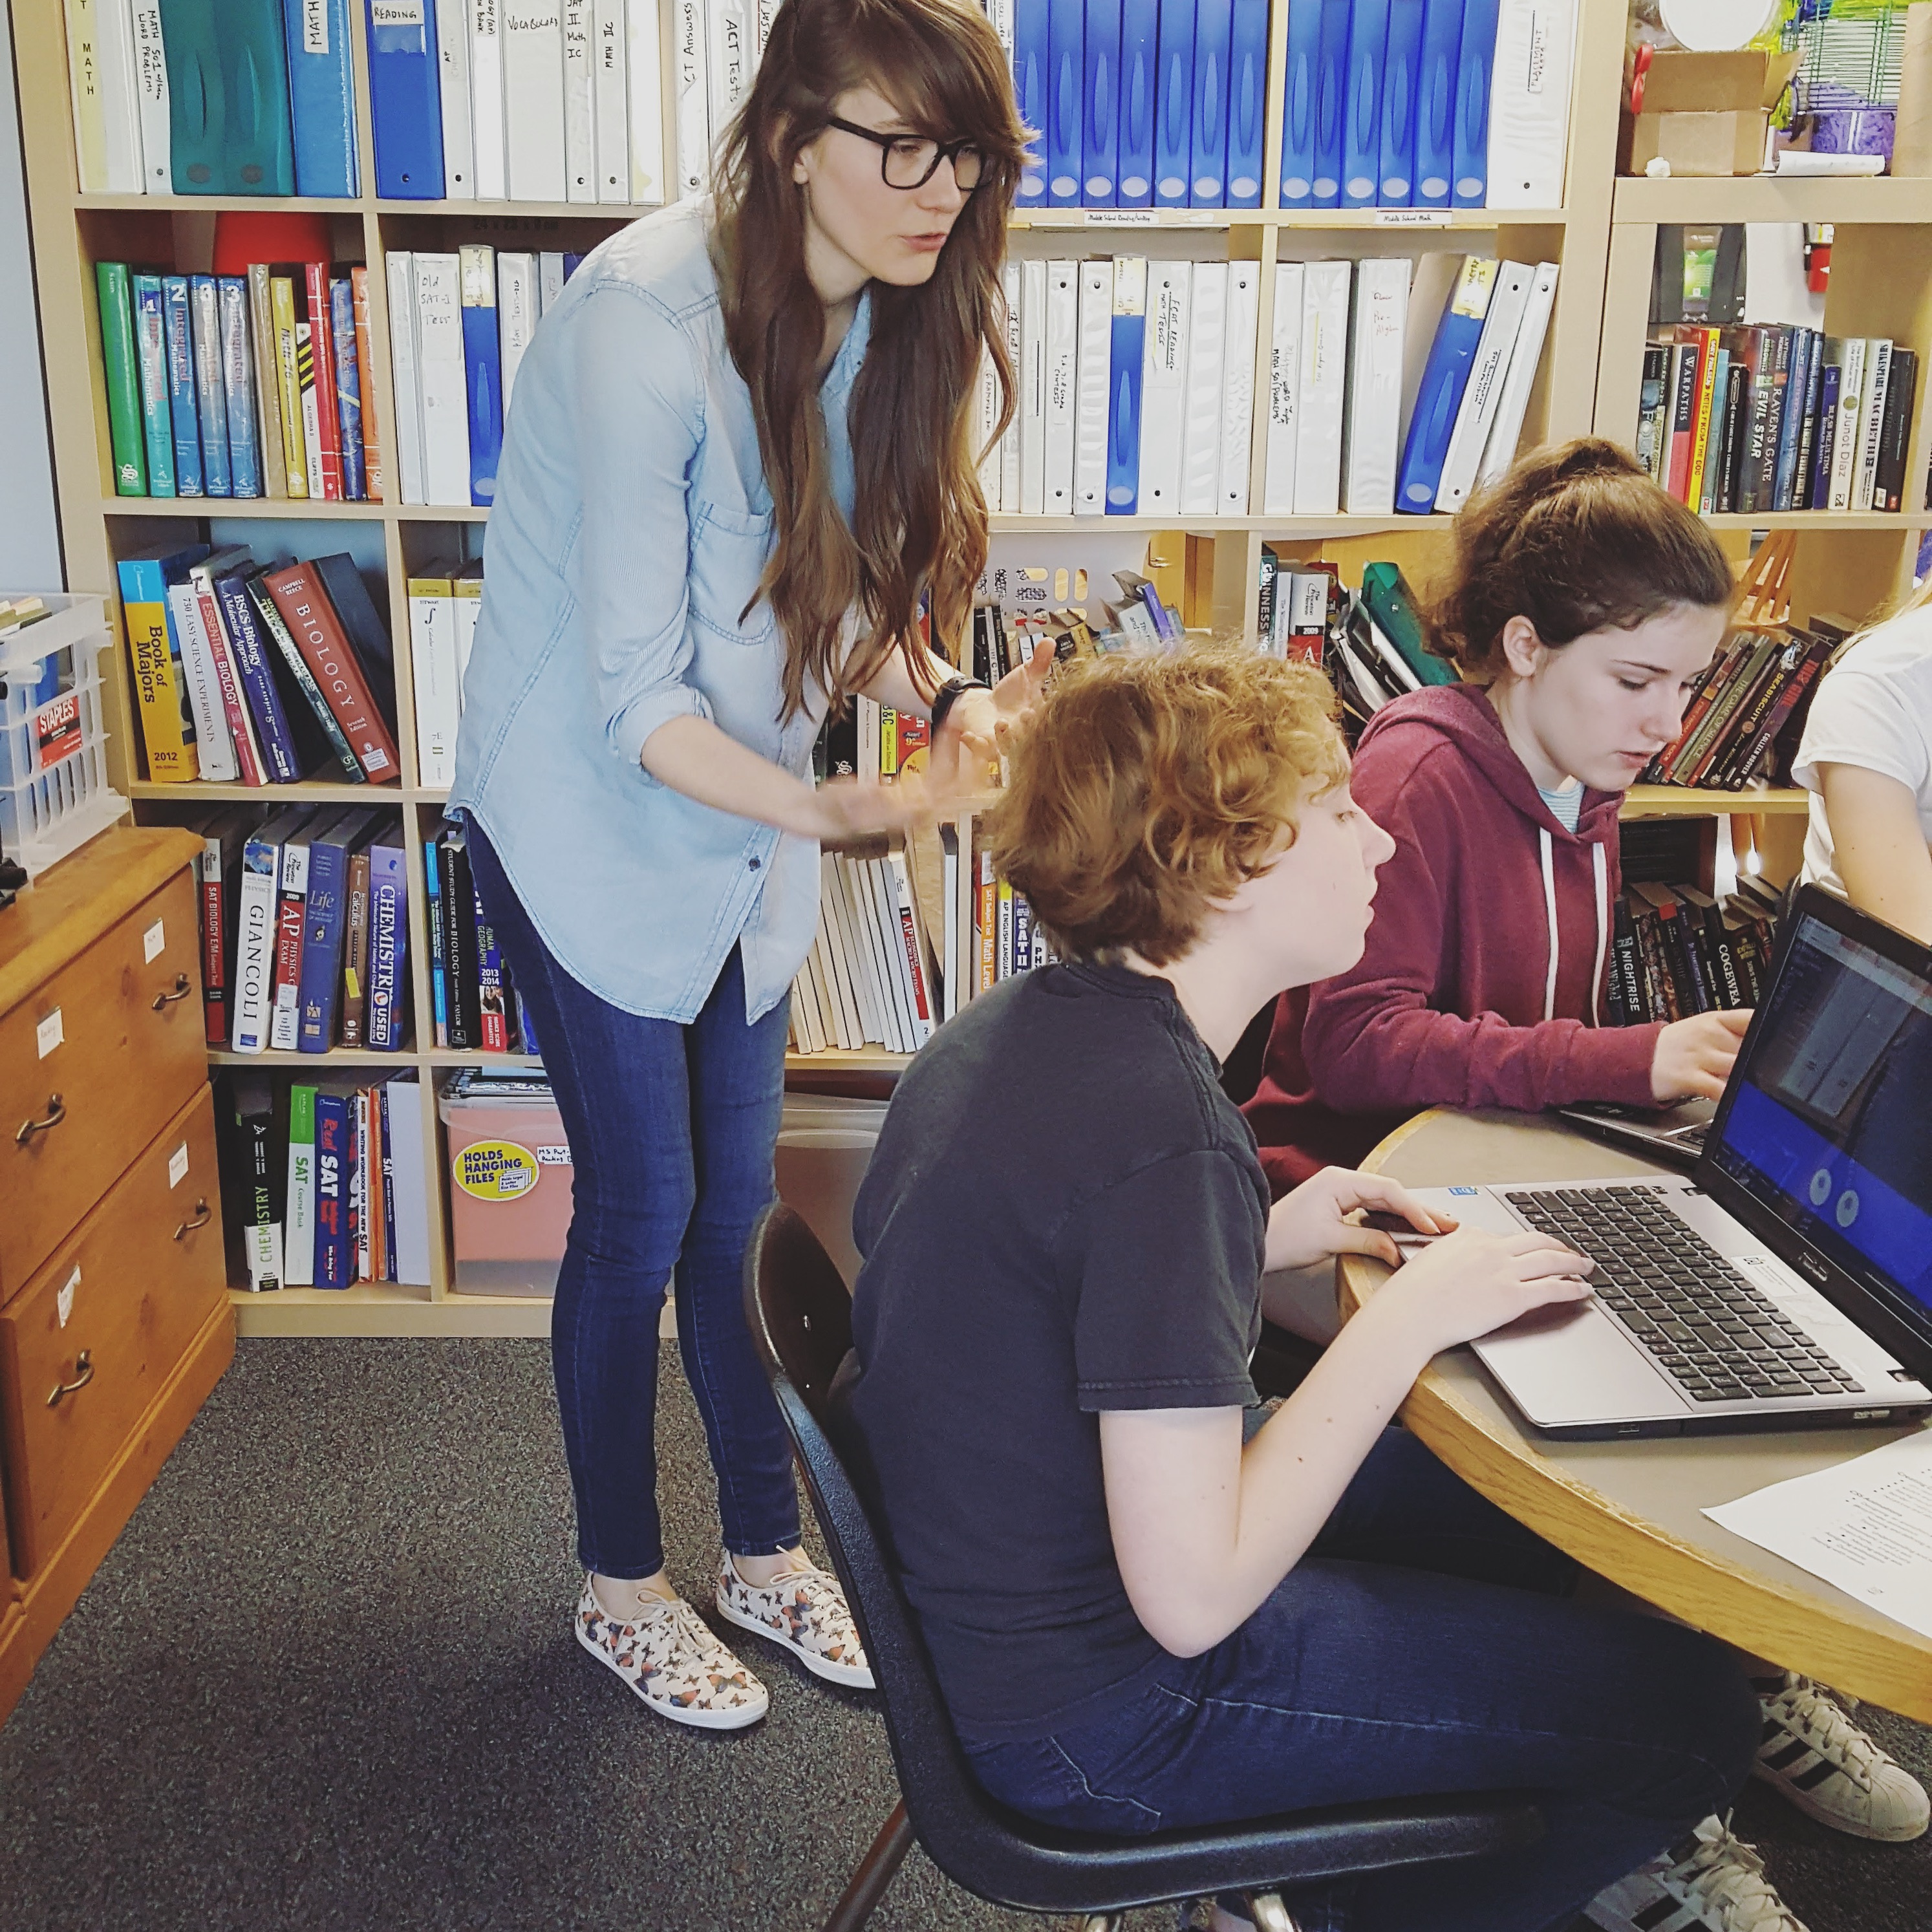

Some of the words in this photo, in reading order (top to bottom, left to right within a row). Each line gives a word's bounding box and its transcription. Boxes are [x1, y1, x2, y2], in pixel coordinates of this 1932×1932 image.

[138, 14, 148, 39] WORD
[147, 10, 159, 38] MATH
[310, 1, 321, 45] MATH
[374, 6, 417, 20] READING
[725, 19, 739, 52] ACT
[142, 46, 153, 92] PROBLEMS
[605, 46, 614, 68] MATH
[729, 59, 741, 102] Tests
[171, 284, 186, 302] 2
[199, 283, 214, 302] 3
[226, 285, 241, 303] 3
[422, 274, 439, 287] Old
[1170, 299, 1180, 324] FCAT
[171, 344, 180, 396] Mathematics
[1874, 343, 1889, 388] SHAKESPEARE
[1679, 356, 1695, 422] WARPATHS
[1701, 391, 1710, 414] NOTES
[1755, 389, 1769, 420] EVIL
[1766, 387, 1783, 444] RAVEN'S
[1698, 417, 1708, 442] FROM
[1842, 413, 1855, 447] Junot
[1866, 391, 1883, 455] MACBETH
[1696, 444, 1704, 458] THE
[1750, 424, 1765, 458] STAR
[1761, 447, 1775, 482] GATE
[277, 578, 306, 593] CAMPBELL
[285, 585, 303, 596] REECE
[1260, 563, 1273, 631] GUINNESS
[182, 597, 191, 612] 730
[186, 614, 196, 636] EASY
[225, 599, 242, 638] Molecular
[236, 636, 253, 674] Approach
[233, 594, 252, 627] BSCS
[243, 624, 261, 667] Biology
[149, 625, 167, 670] Book
[189, 636, 204, 676] SCIENCE
[202, 603, 225, 660] ESSENTIAL
[217, 661, 239, 705] BIOLOGY
[295, 602, 355, 707] BIOLOGY
[136, 641, 155, 703] Majors
[157, 673, 167, 688] of
[1738, 680, 1748, 692] THE
[197, 678, 215, 743] EXPERIMENTS
[1724, 692, 1740, 714] GAME
[1751, 672, 1785, 723] SEABISCUIT
[39, 698, 74, 734] STAPLES
[347, 716, 366, 727] Seventh
[349, 722, 367, 733] Edition
[154, 751, 178, 762] 2012
[1755, 732, 1771, 757] COLLEEN
[208, 886, 217, 902] SAT
[310, 889, 334, 908] Life
[350, 890, 360, 927] Calculus
[1004, 901, 1008, 911] AP
[209, 903, 219, 938] BIOLOGY
[283, 906, 301, 938] AP
[902, 919, 914, 937] AP
[209, 938, 219, 954] E/M
[477, 925, 488, 966] GEOGRAPHY
[1017, 918, 1029, 953] SAT
[242, 905, 264, 1020] GIANCOLI
[280, 939, 288, 965] EXAM
[288, 940, 299, 977] PHYSICS
[451, 930, 460, 977] BIOLOGY
[983, 938, 993, 963] Math
[481, 968, 499, 977] 2013
[482, 977, 500, 986] 2014
[983, 965, 992, 989] Level
[1621, 950, 1640, 1013] NIGHTRISE
[1719, 943, 1741, 1007] COGEWEA
[376, 1007, 387, 1042] USED
[323, 1118, 338, 1152] Real
[295, 1156, 308, 1185] SAT
[383, 1157, 392, 1177] SAT
[464, 1149, 503, 1163] HOLDS
[464, 1158, 522, 1174] HANGING
[321, 1154, 339, 1197] SAT
[465, 1172, 495, 1185] FILES
[255, 1185, 272, 1263] CHEMISTRY
[359, 1234, 368, 1253] SAT
